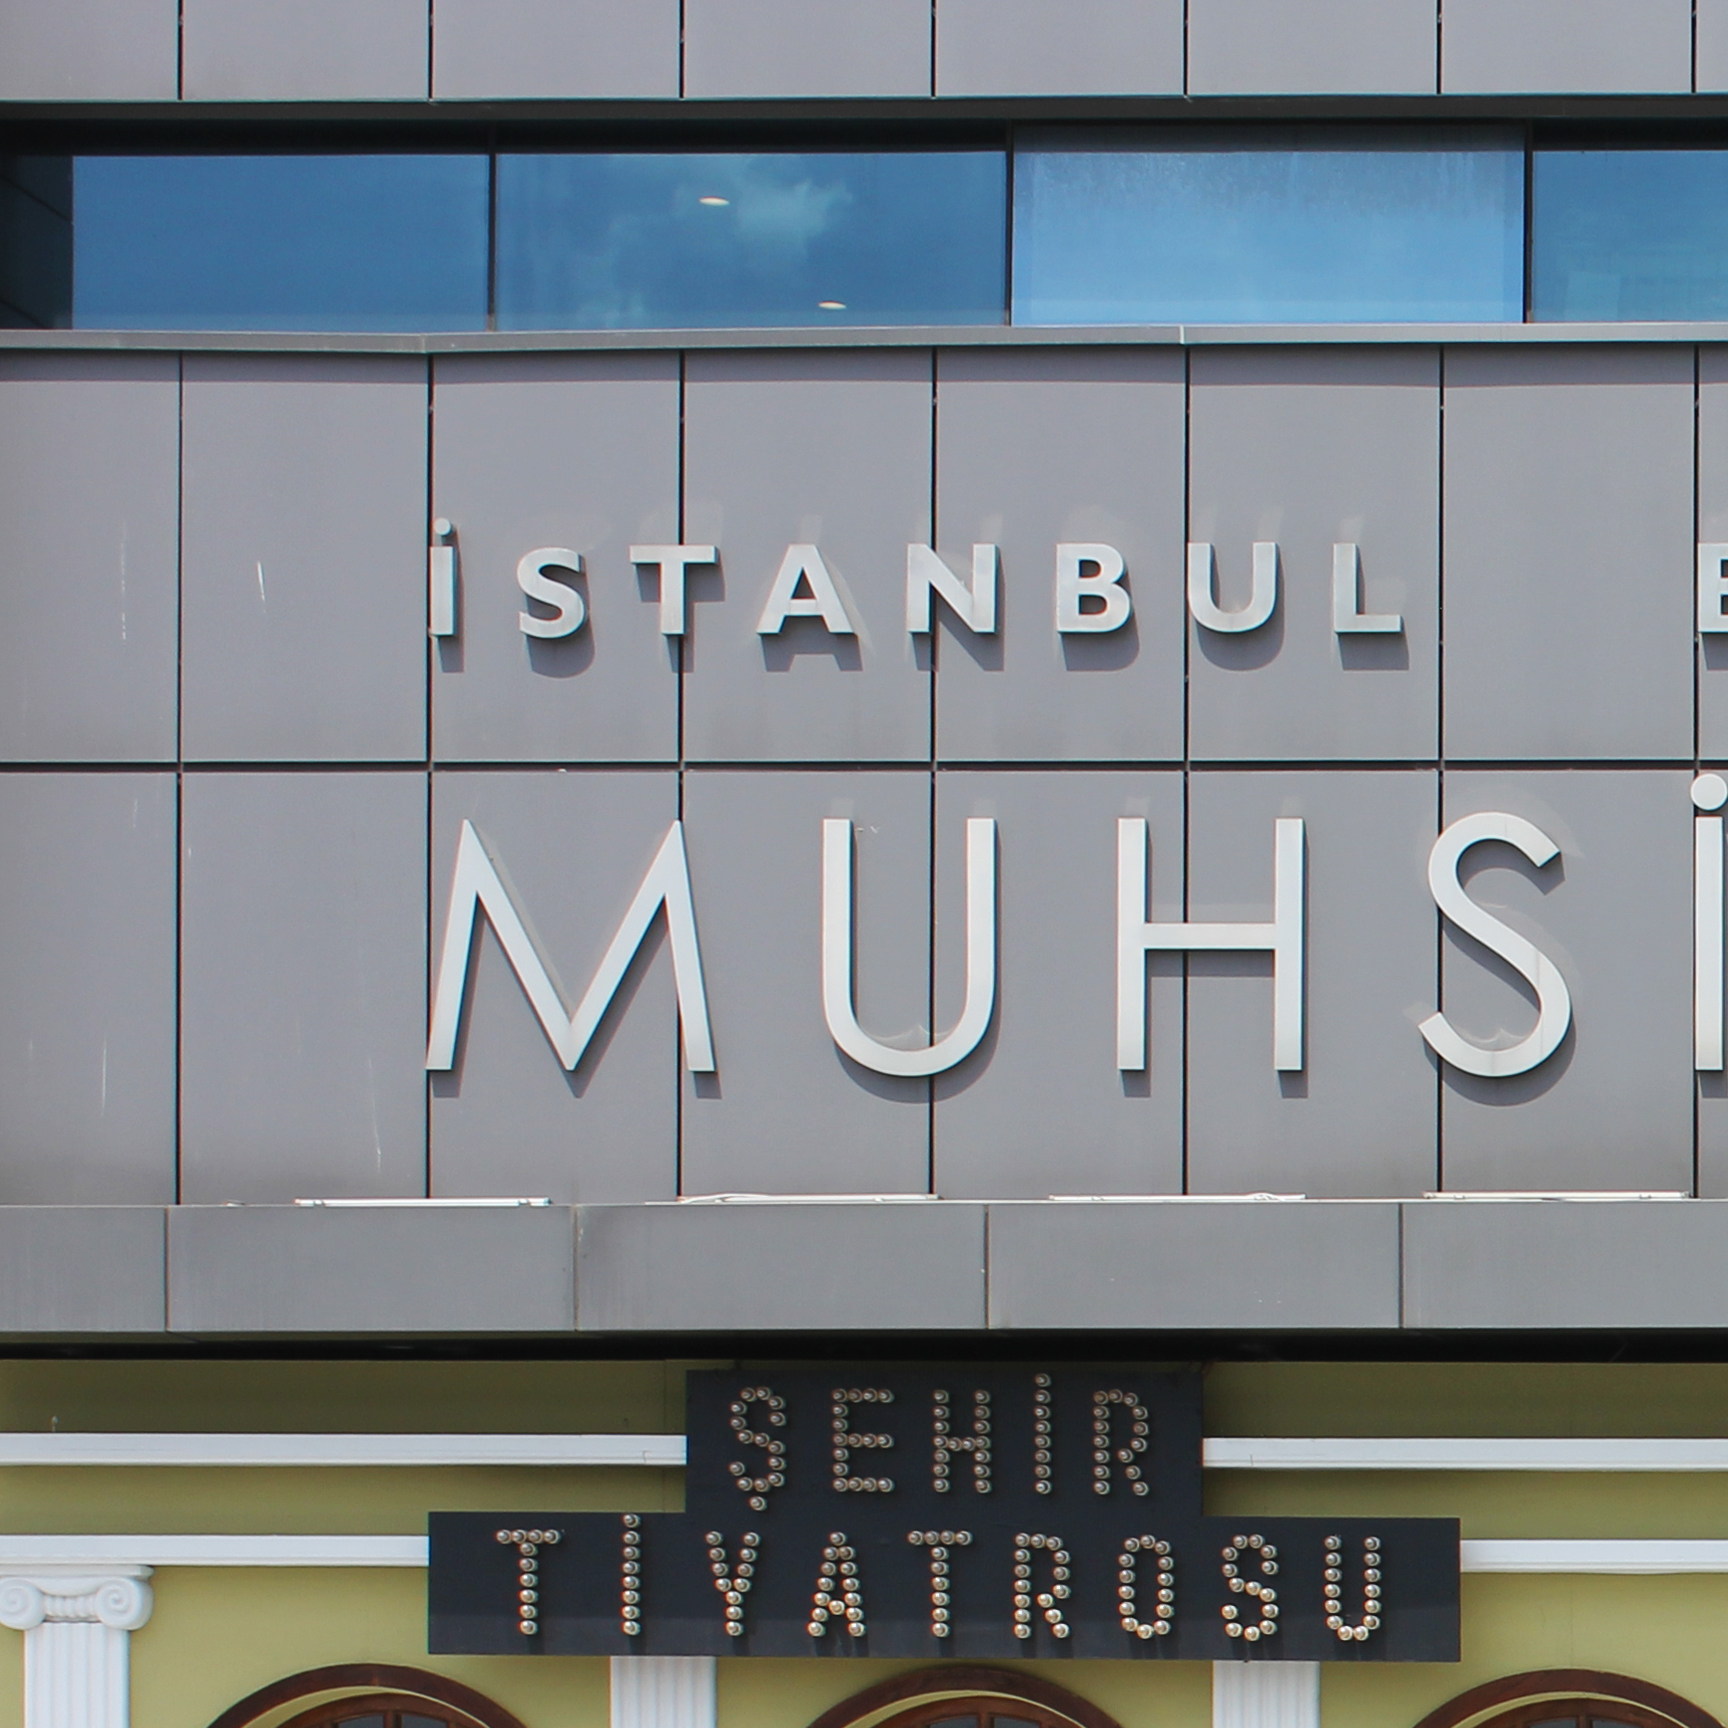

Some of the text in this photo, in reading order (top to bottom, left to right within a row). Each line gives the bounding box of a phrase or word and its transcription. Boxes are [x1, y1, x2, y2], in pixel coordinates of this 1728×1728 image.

[429, 517, 1402, 640] İSTANBUL
[729, 1372, 1151, 1512] ŞEHİR
[495, 1512, 1382, 1642] TİYATROSU
